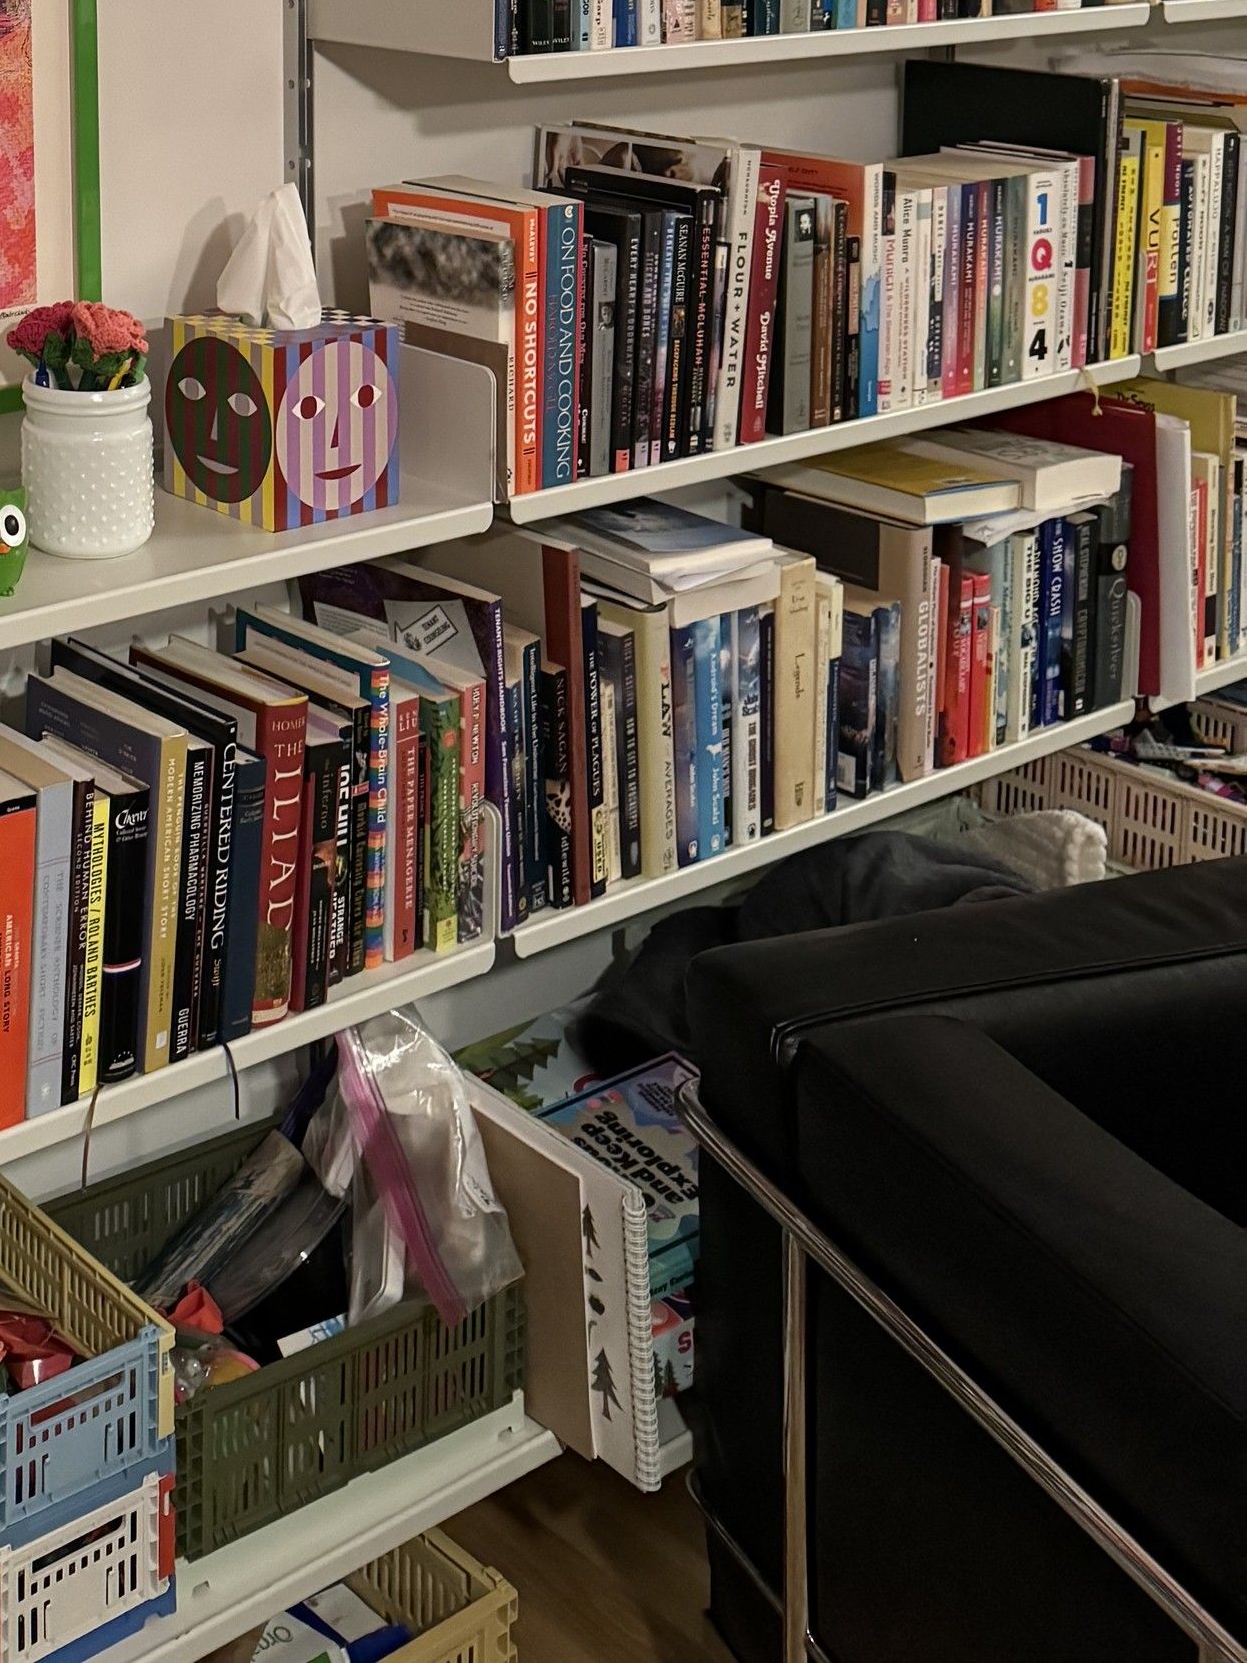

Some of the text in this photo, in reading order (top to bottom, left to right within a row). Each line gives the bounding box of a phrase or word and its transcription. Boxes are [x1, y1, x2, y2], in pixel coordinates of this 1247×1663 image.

[677, 224, 689, 259] SEANAN
[733, 232, 748, 299] FLOUR
[764, 179, 780, 281] Utopia Avenue
[901, 197, 913, 264] Alice Munro
[963, 221, 975, 283] MURAKAMI
[993, 215, 1003, 283] MURAKAMI
[1145, 208, 1161, 284] VURT
[1170, 216, 1181, 284] Pollen
[522, 283, 538, 443] NO SHORTCUTS
[555, 226, 576, 479] ON FOOD AND COOKING
[725, 318, 741, 388] WATER
[754, 311, 771, 410] David Mitchell
[1049, 529, 1064, 618] SNOW CRASH
[915, 600, 929, 718] GLOBALISTS
[274, 740, 303, 758] THE
[376, 674, 390, 825] The Whole-Brain Child
[556, 676, 568, 774] NICK SAGAN
[78, 792, 95, 950] BEHIND HUMAN ERROR
[184, 760, 205, 921] MEMORIZING PHARMACOLOGY
[210, 742, 237, 950] CENTERED RIDING
[267, 763, 303, 932] ILIAD
[404, 748, 416, 910] THE PAPER MENAGERIE
[84, 822, 105, 1018] MYTHOLOGIES ROLAND BARTHES
[2, 914, 14, 1034] AMERICAN LONG STORY
[176, 1007, 190, 1055] GUERRA
[581, 1122, 684, 1203] and Keep
[594, 1109, 699, 1201] Exploring
